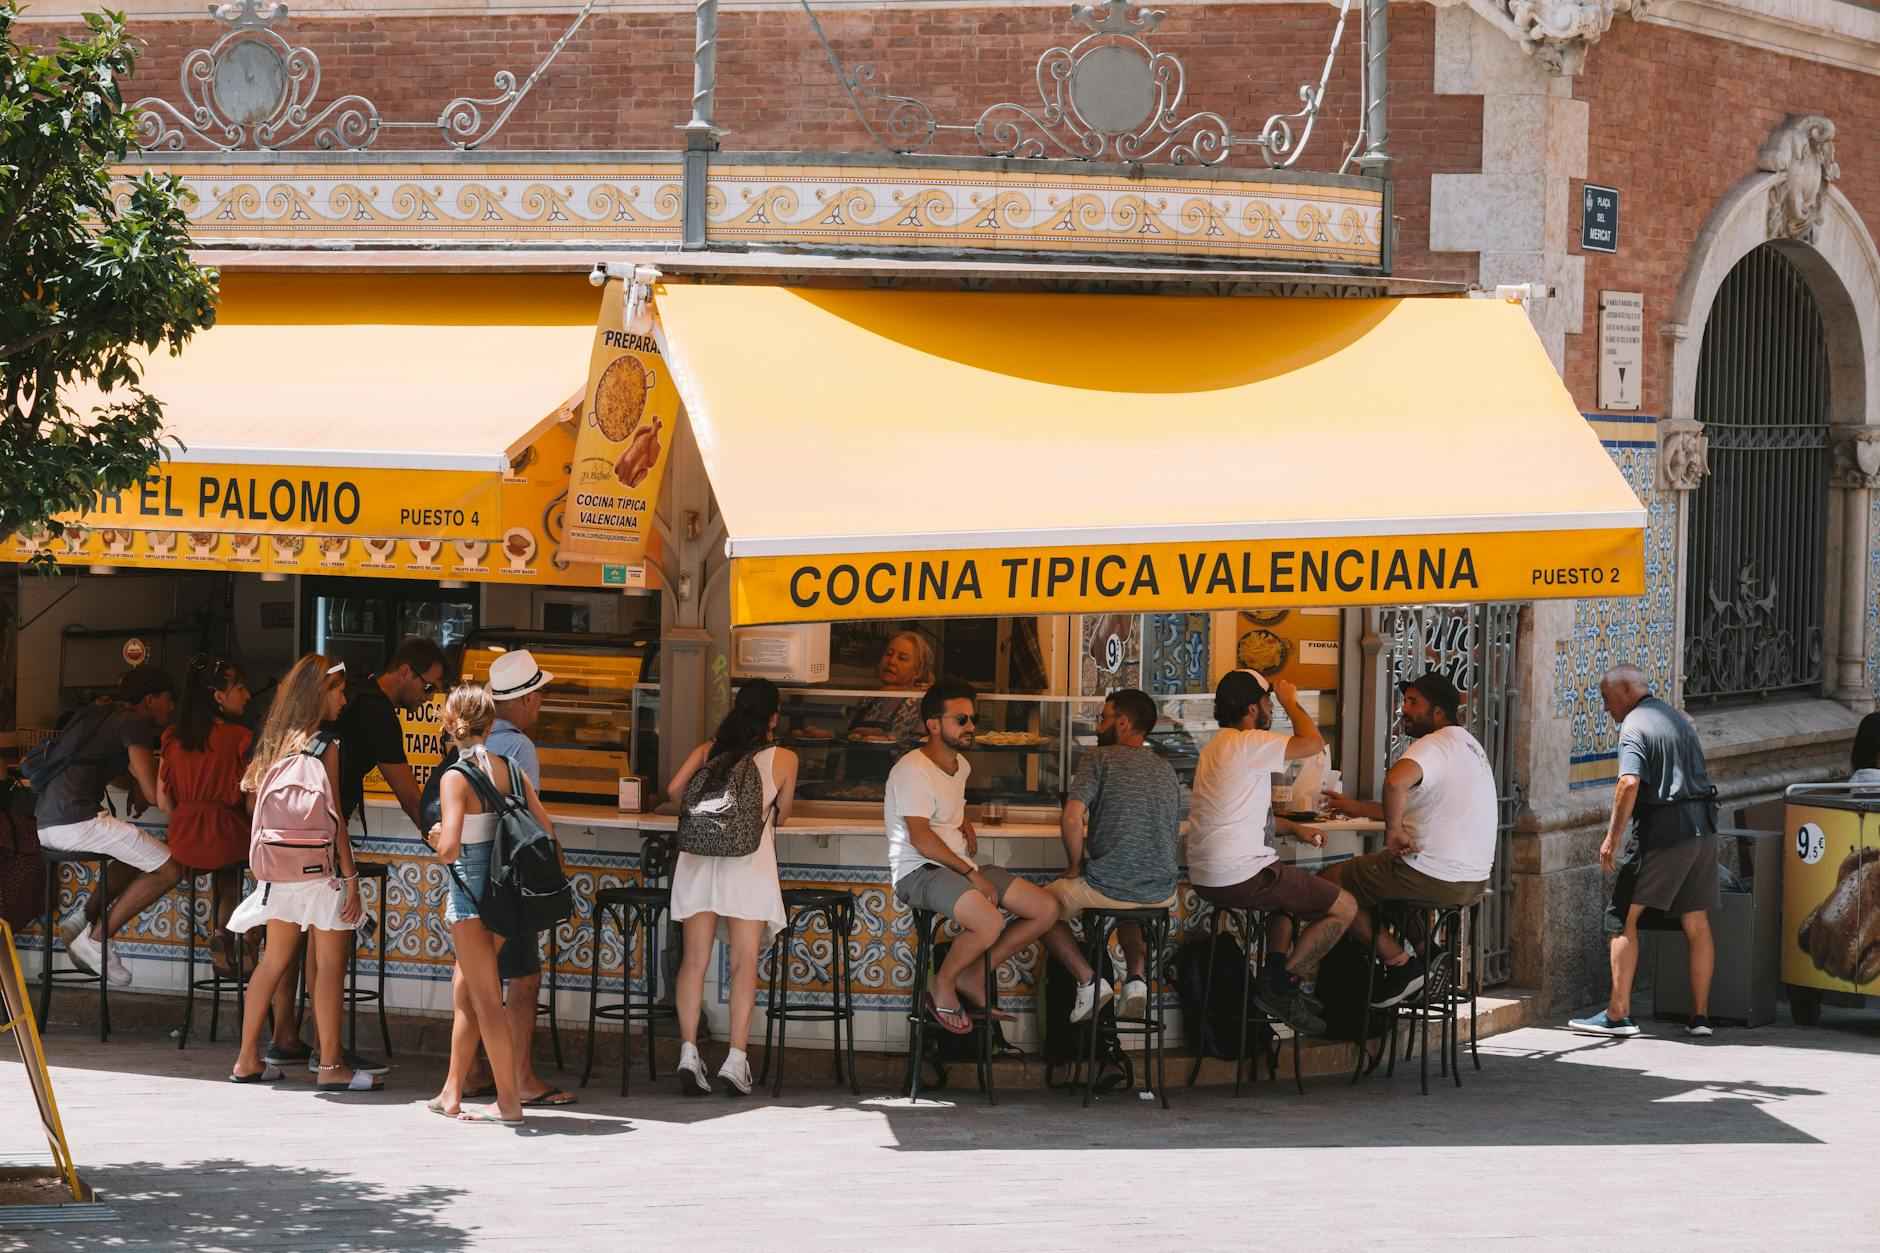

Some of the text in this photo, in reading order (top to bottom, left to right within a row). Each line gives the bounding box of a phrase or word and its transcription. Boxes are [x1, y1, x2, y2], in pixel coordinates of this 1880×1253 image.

[1589, 227, 1612, 242] MERCAT
[604, 330, 661, 354] PREPARA
[140, 476, 183, 517] EL
[199, 476, 361, 525] PALOMO
[576, 493, 614, 509] COCINA
[400, 507, 481, 528] PUESTO 4
[579, 511, 637, 529] VALENCIANA
[789, 547, 1479, 608] COCINA TIPICA VALENCIANA
[1532, 566, 1621, 586] PUESTO 2
